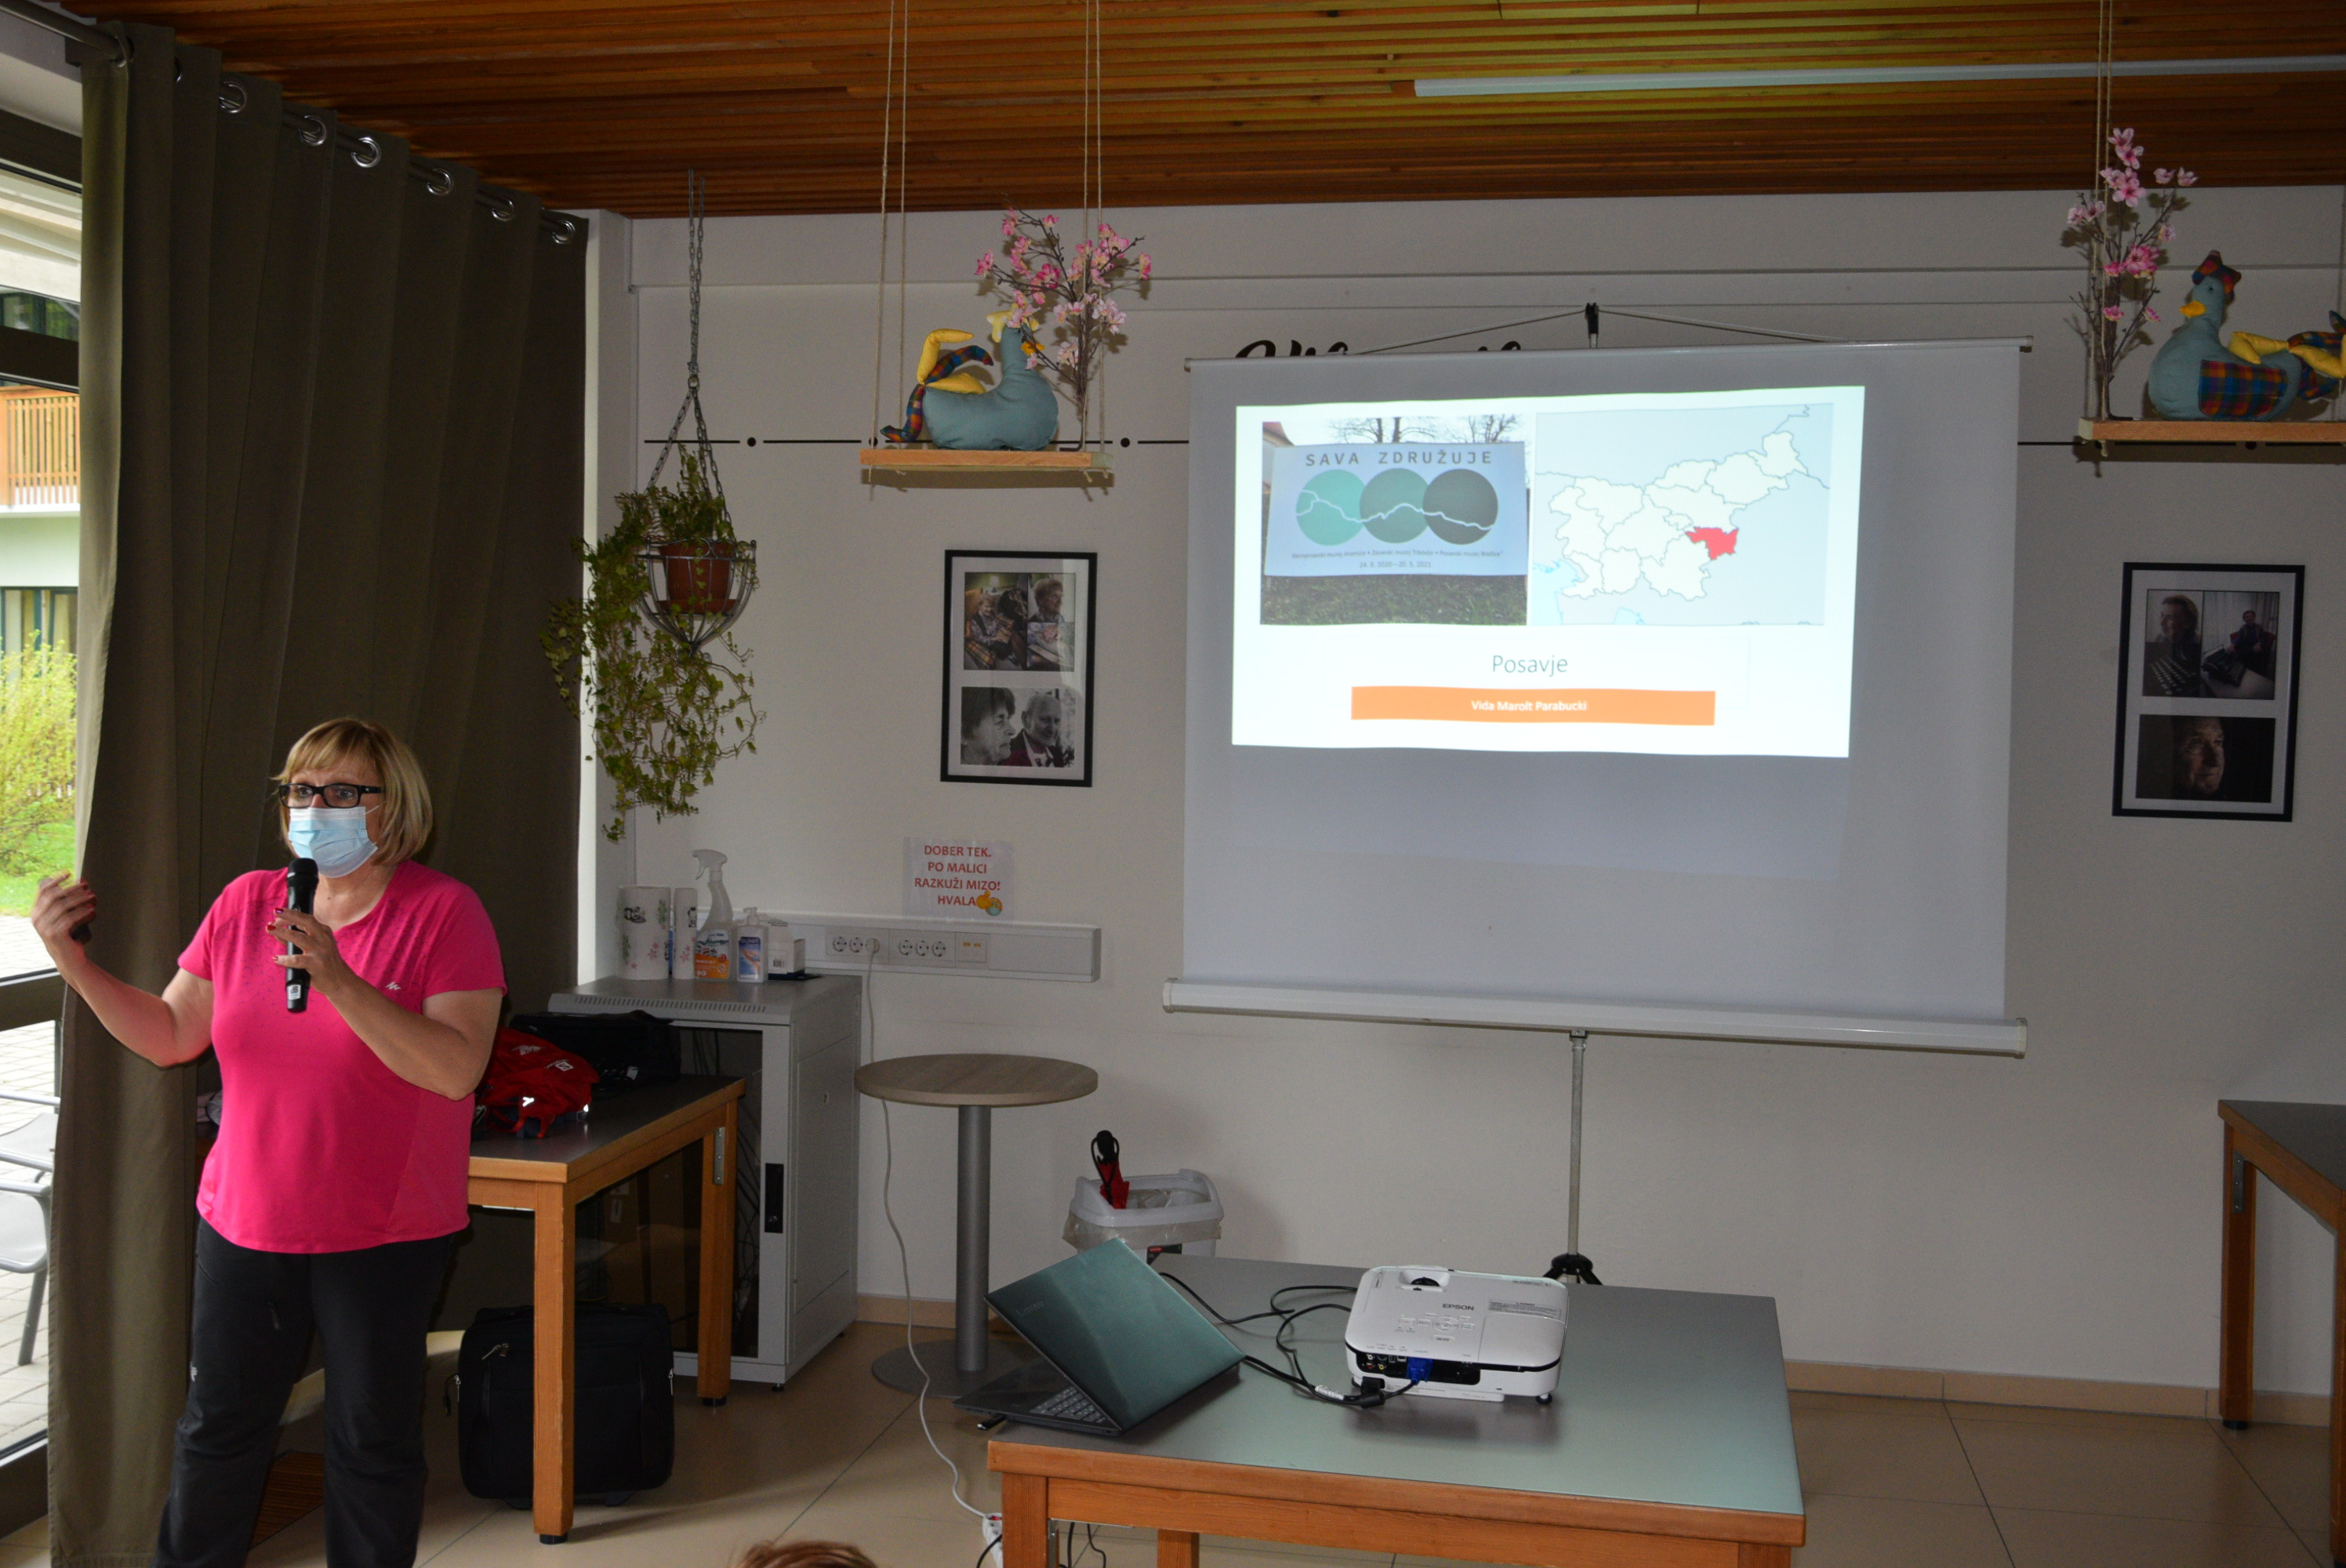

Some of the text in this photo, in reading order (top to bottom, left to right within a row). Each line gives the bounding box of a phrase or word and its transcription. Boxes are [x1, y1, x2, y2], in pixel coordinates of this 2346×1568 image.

[1306, 449, 1491, 466] SAVA ZDRUŽUJE
[1492, 655, 1568, 677] Posavje
[1471, 700, 1588, 711] Vida Marolt Parabucki
[924, 845, 991, 857] DOBER TEK.
[928, 862, 986, 873] PO MALICI
[914, 877, 1000, 891] RAZKUŽI MIZO!
[938, 895, 976, 906] HVALA
